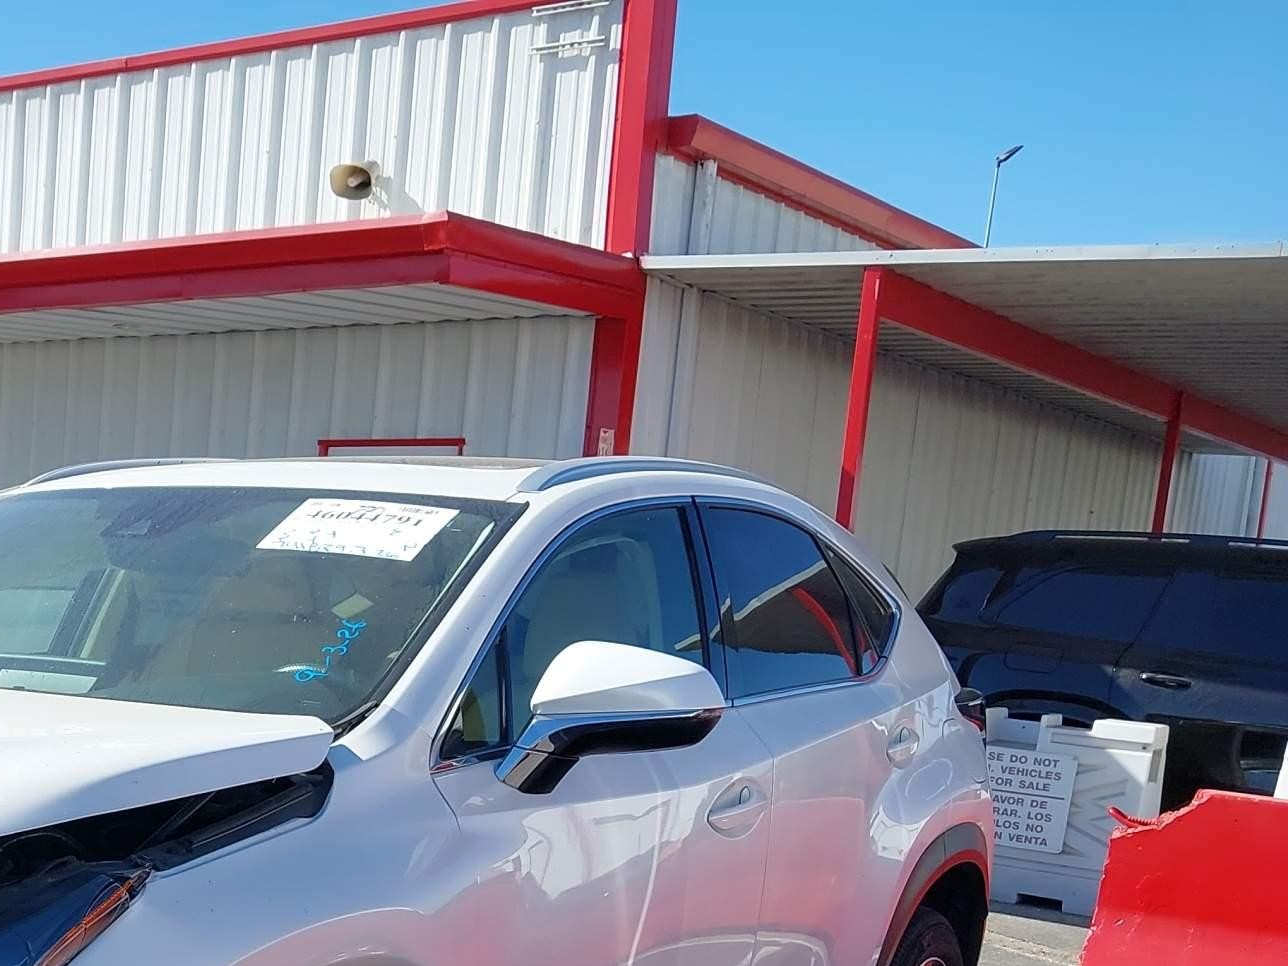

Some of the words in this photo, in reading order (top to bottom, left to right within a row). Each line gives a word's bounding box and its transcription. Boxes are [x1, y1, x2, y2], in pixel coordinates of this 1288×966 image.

[1010, 754, 1028, 765] DO
[1033, 757, 1060, 768] NOT
[1001, 766, 1062, 781] VEHICLES
[1018, 780, 1051, 792] SALE
[1030, 800, 1048, 809] DE
[1027, 812, 1053, 823] LOS
[993, 819, 1020, 830] LOS
[1025, 824, 1044, 833] NO
[1008, 833, 1048, 847] VENTA
